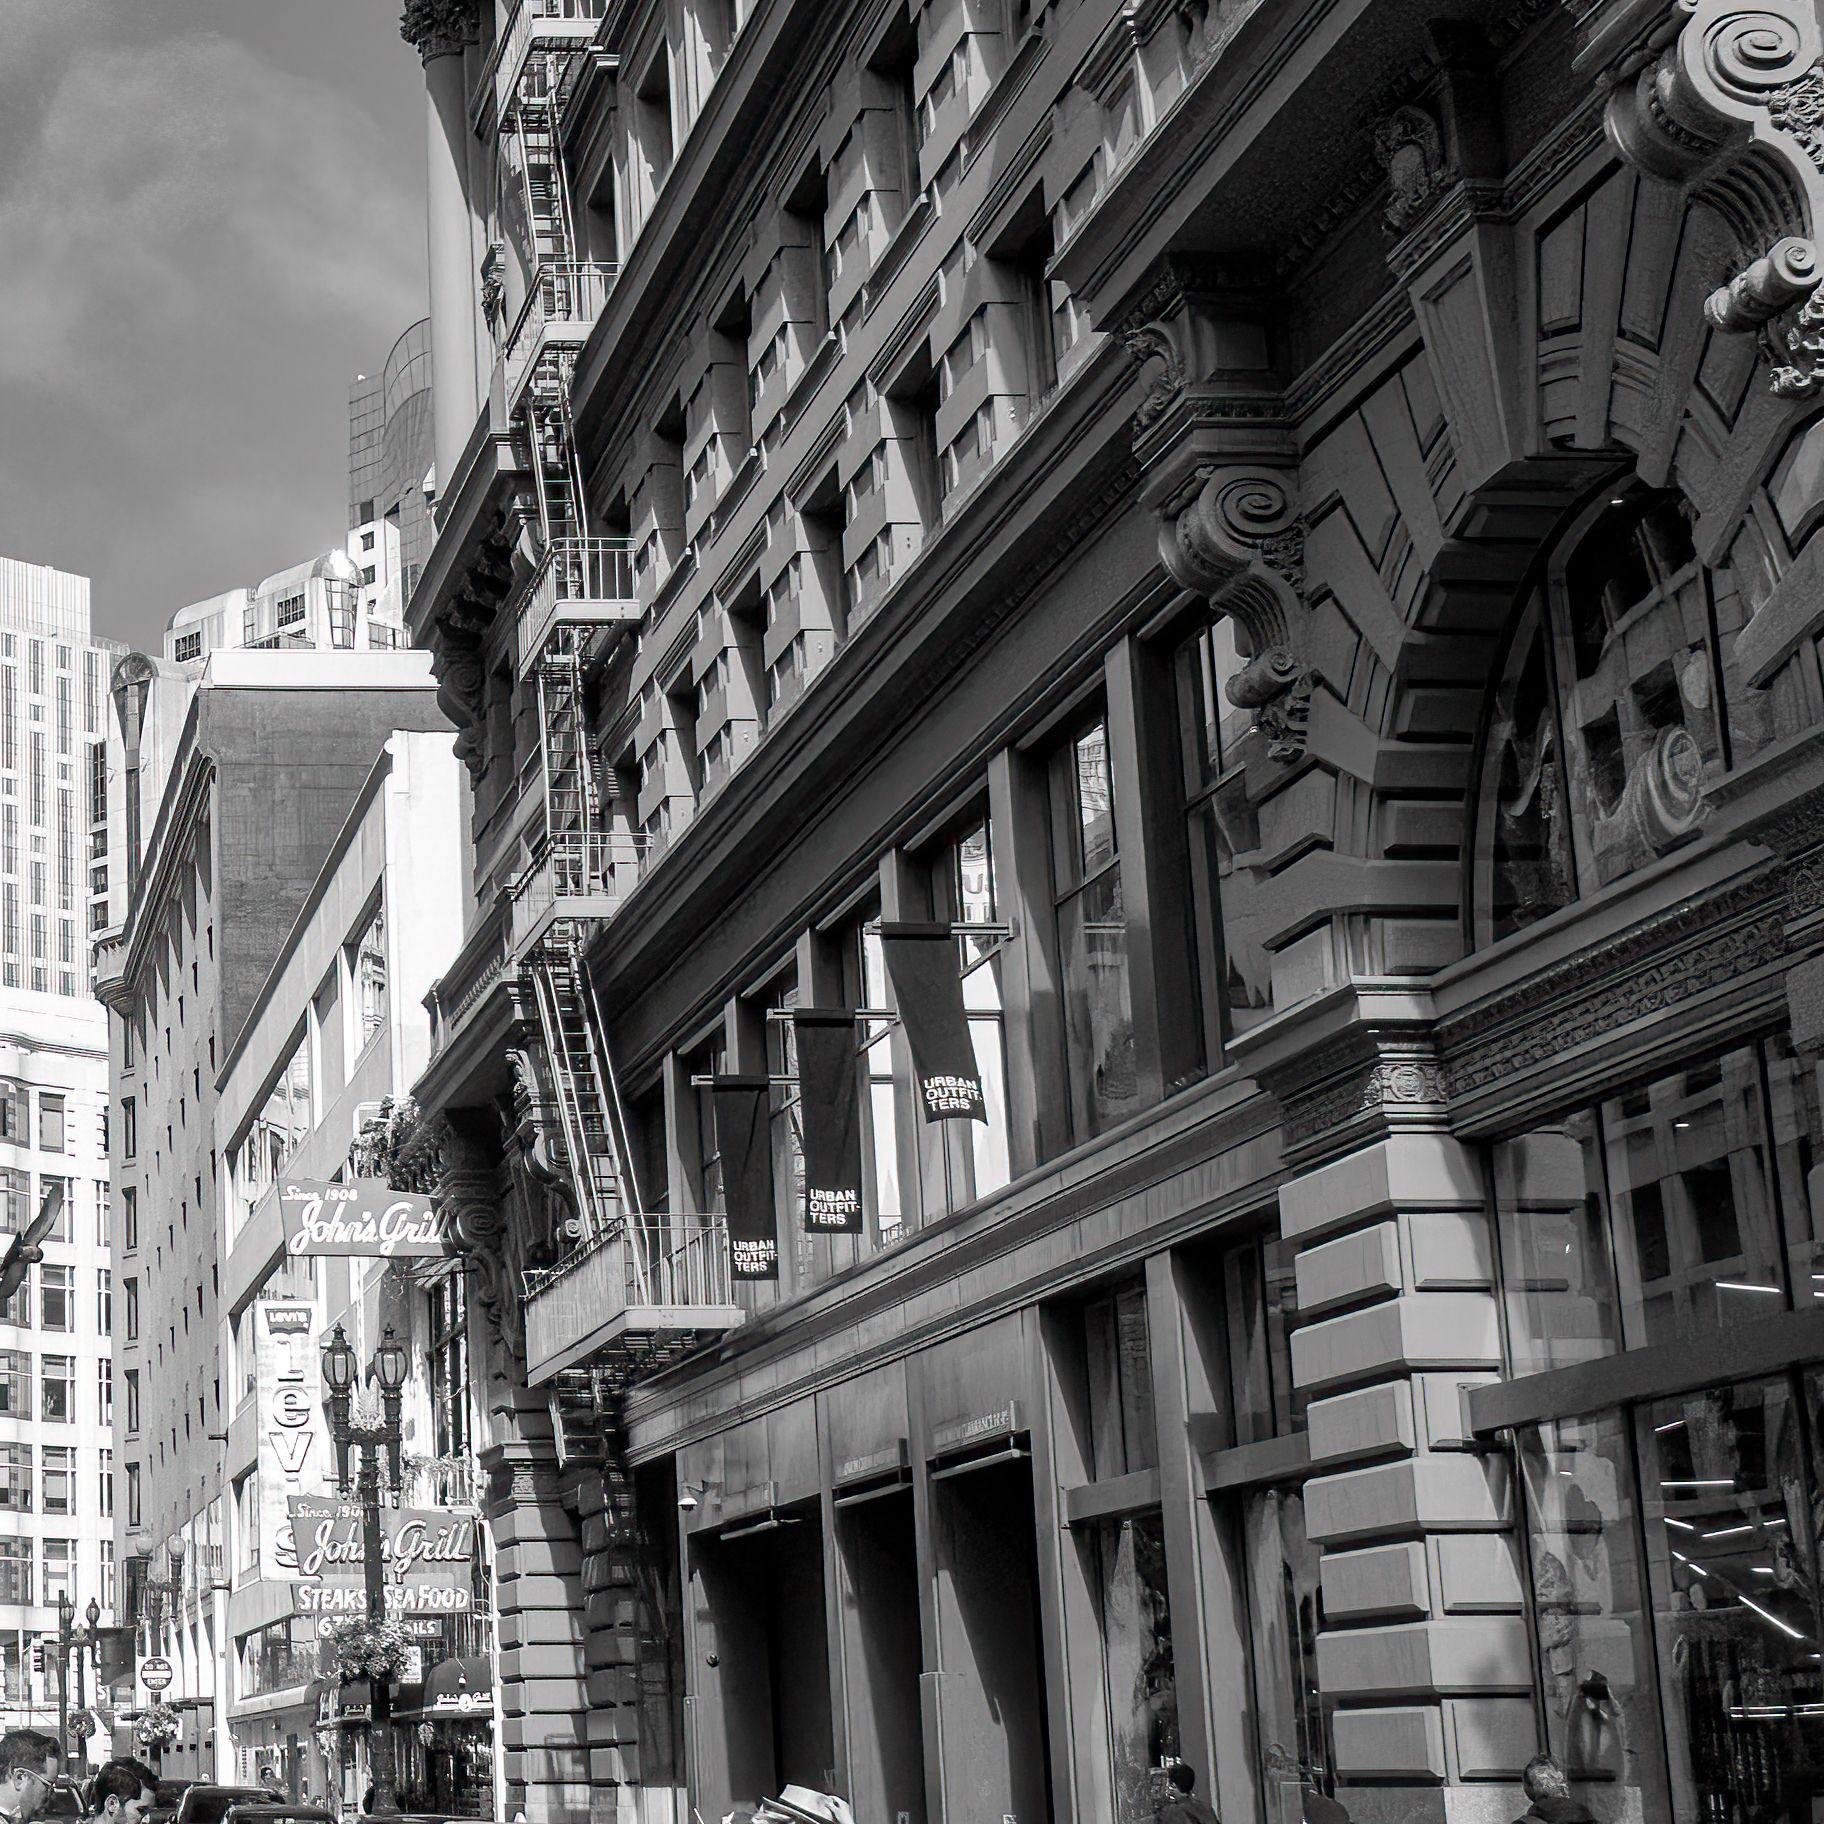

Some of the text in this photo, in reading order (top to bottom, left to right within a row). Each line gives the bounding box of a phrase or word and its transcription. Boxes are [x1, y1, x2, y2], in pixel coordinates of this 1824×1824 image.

[924, 1075, 978, 1090] URBAN
[927, 1097, 971, 1112] TERS
[281, 1184, 359, 1202] Since 1908
[809, 1188, 856, 1201] URBAN
[809, 1211, 847, 1225] TERS
[289, 1198, 378, 1256] John's
[733, 1239, 775, 1251] URBAN
[734, 1261, 769, 1273] TERS
[393, 1518, 472, 1574] Grill
[298, 1584, 368, 1611] STEAKS
